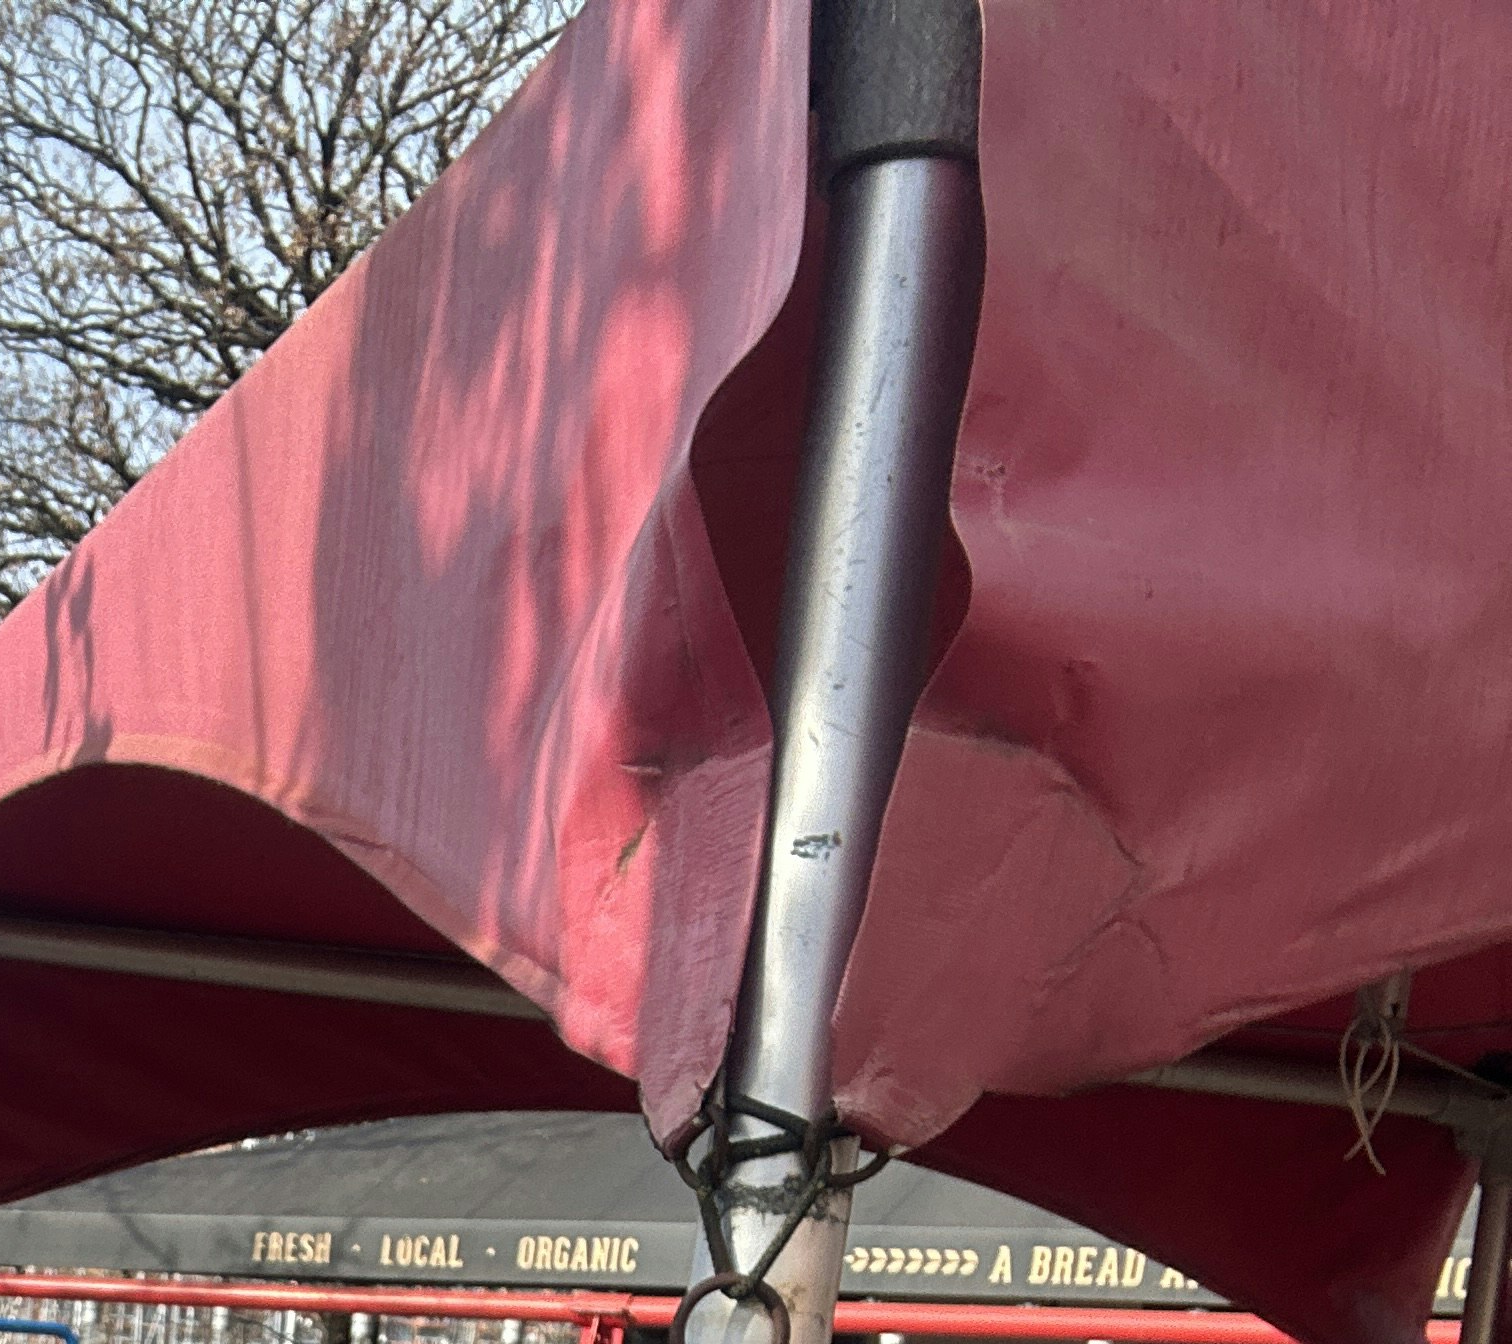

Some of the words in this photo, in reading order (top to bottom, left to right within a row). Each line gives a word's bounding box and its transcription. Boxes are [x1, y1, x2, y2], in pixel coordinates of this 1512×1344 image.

[252, 1232, 332, 1264] FRESH
[380, 1234, 464, 1269] LOCAL
[517, 1236, 640, 1273] ORGANIC
[989, 1244, 1013, 1285] A
[1028, 1246, 1146, 1288] BREAD
